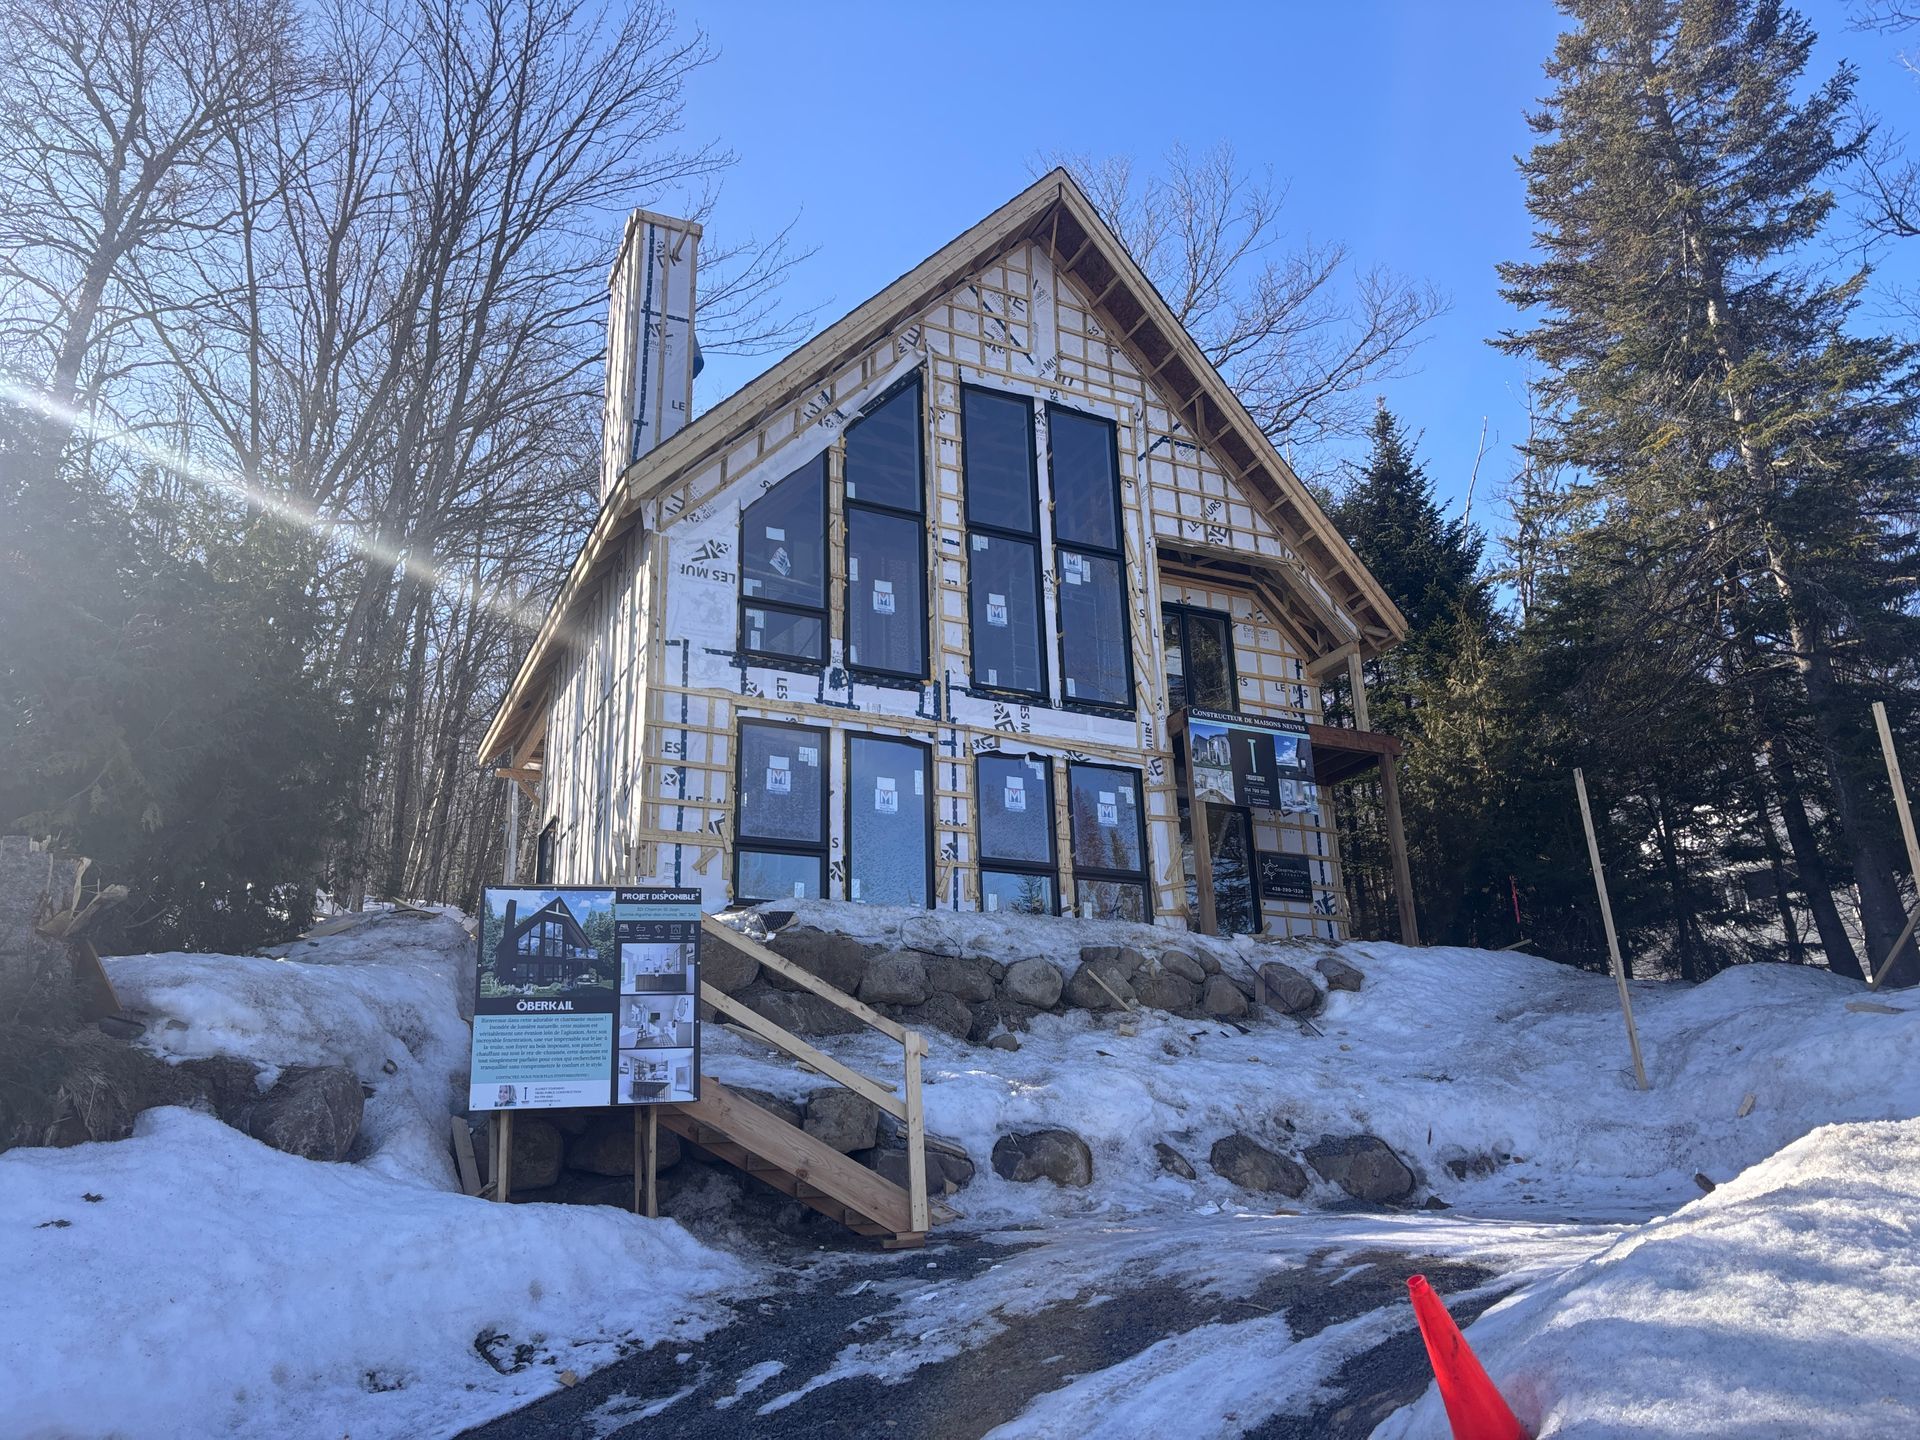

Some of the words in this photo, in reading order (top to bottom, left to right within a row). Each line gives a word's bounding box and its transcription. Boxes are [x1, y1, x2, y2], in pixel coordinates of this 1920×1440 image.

[1192, 708, 1243, 722] CONSTRUCTEUR
[1253, 719, 1281, 728] MAISONS
[1282, 723, 1306, 732] NEUVES
[622, 893, 650, 901] PROJET
[651, 893, 696, 901] DISPONIBLE
[516, 999, 574, 1011] ÖBERKAIL
